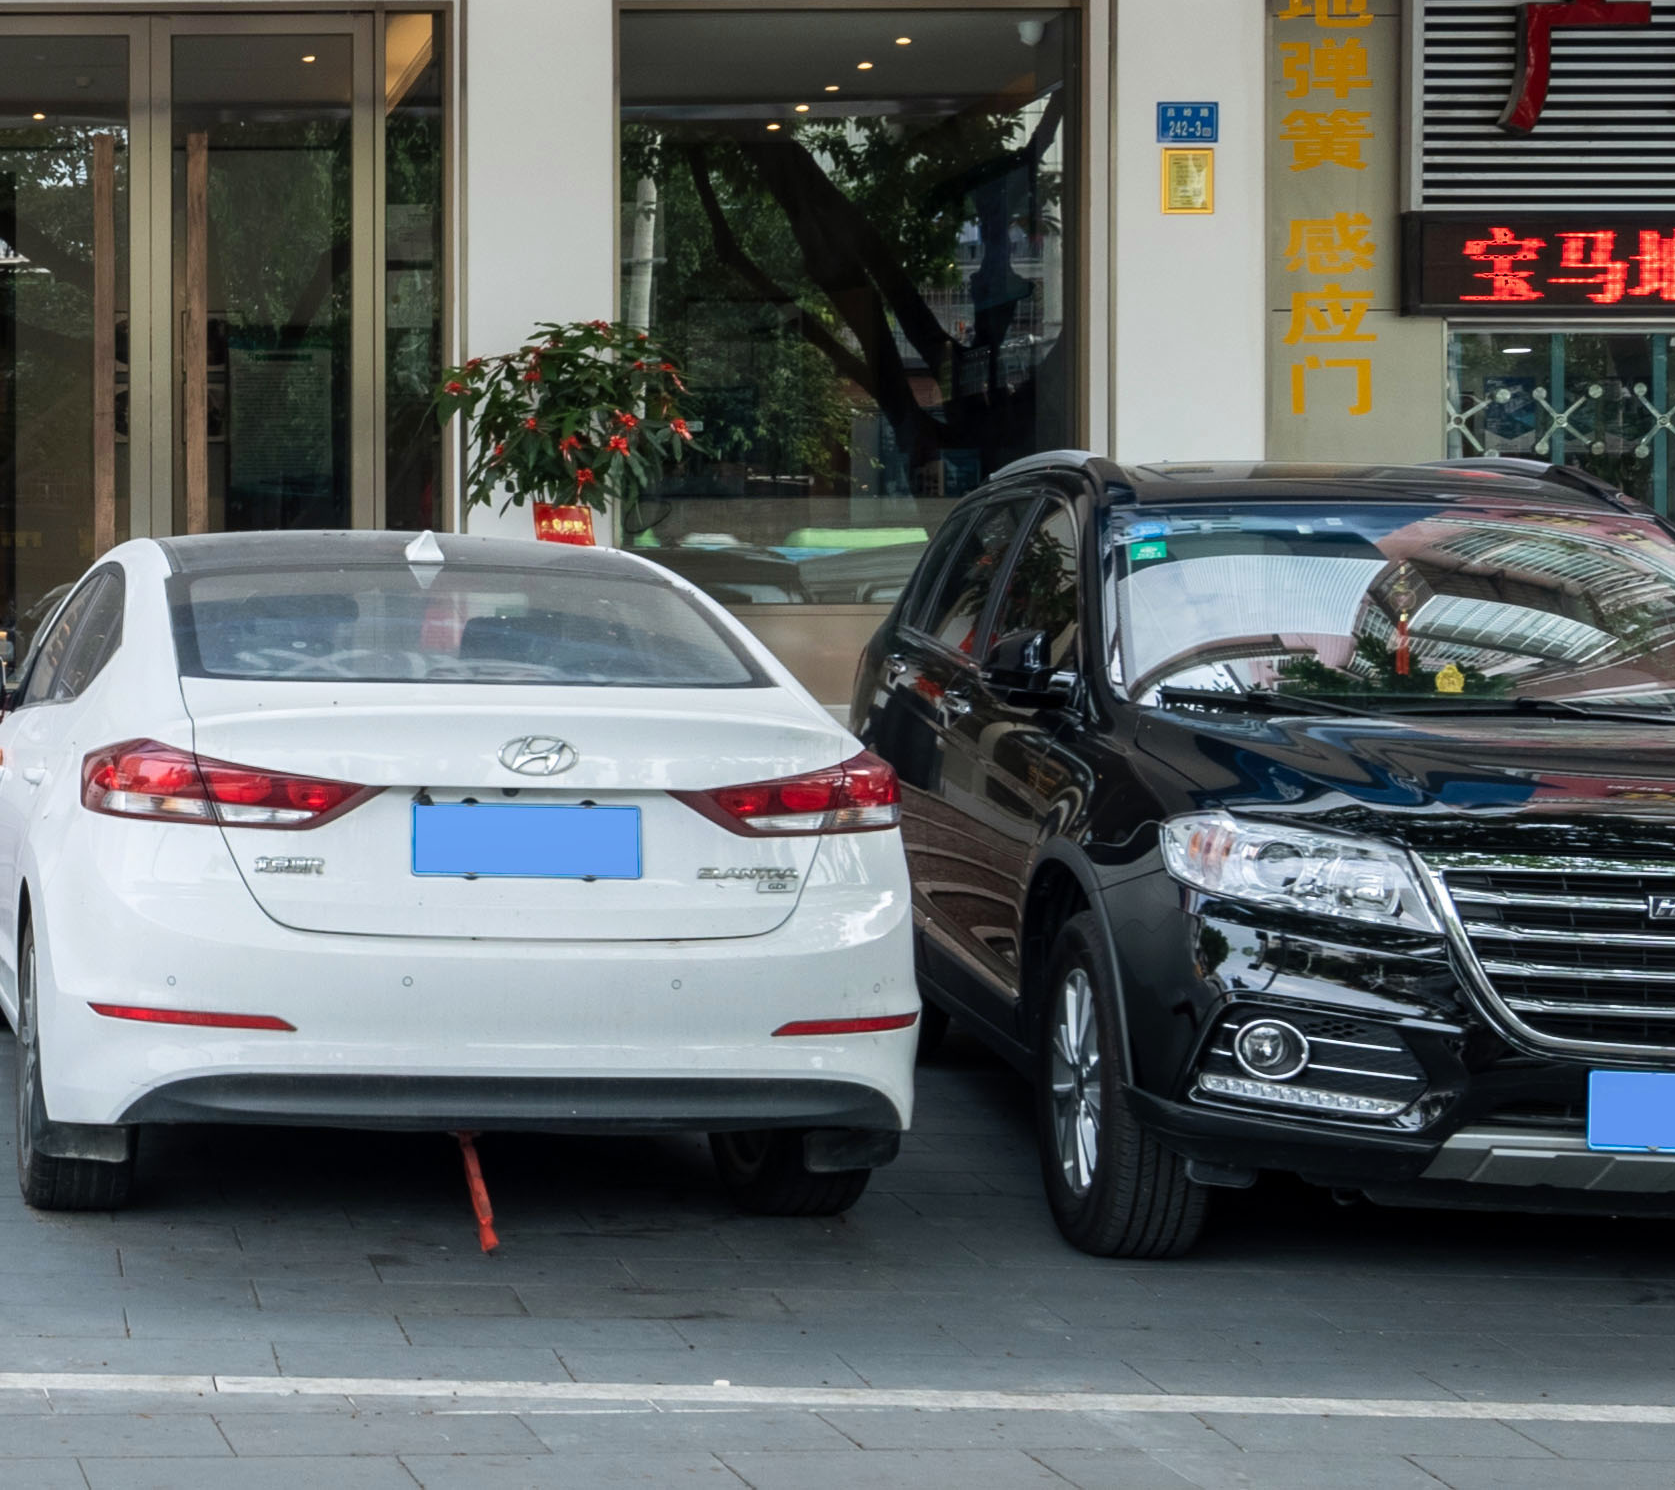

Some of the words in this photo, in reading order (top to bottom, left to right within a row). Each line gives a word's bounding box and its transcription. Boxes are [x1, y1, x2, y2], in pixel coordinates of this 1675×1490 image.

[1283, 212, 1378, 416] 感应门
[697, 867, 799, 879] ELANTRA
